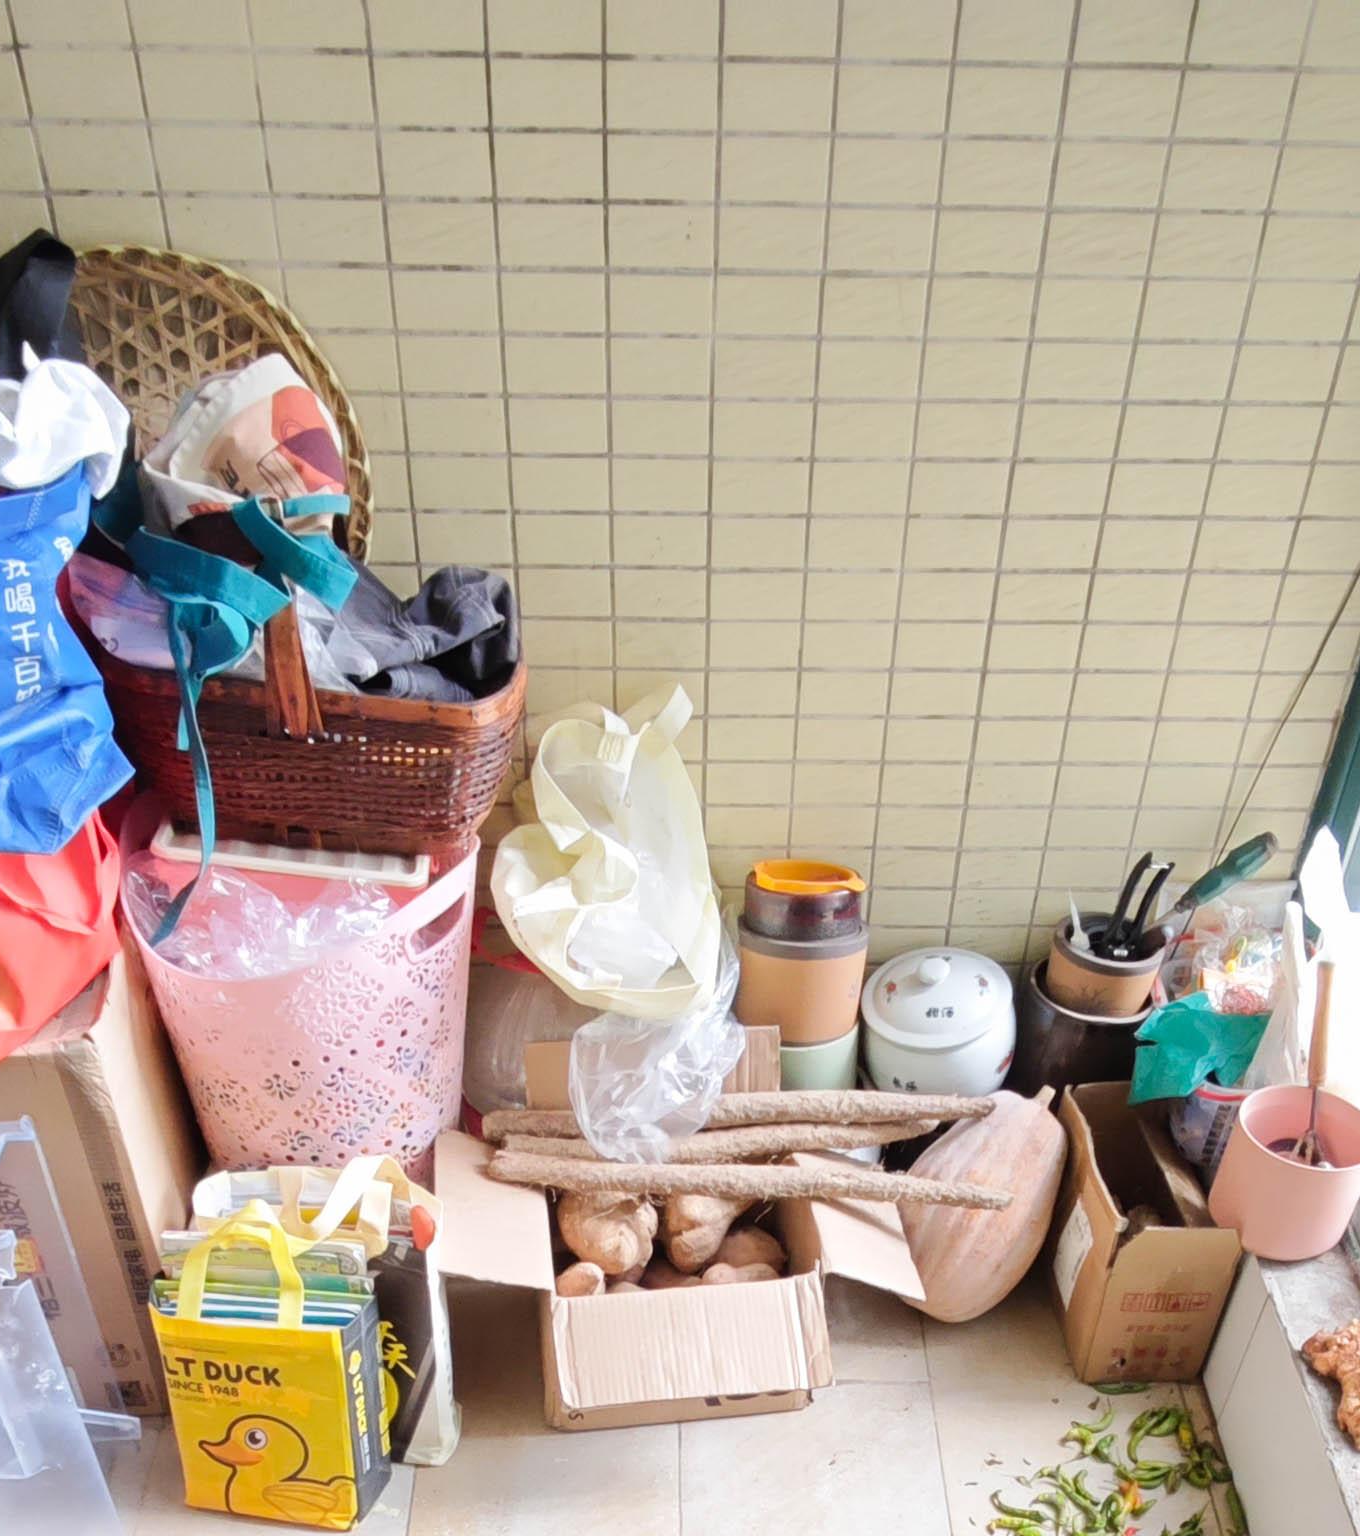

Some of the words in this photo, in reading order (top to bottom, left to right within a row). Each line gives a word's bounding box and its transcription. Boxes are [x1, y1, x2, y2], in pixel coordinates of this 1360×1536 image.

[102, 1182, 136, 1242] 品质生活
[163, 1354, 196, 1377] LT
[204, 1360, 282, 1387] DUCK
[209, 1383, 240, 1398] 1948
